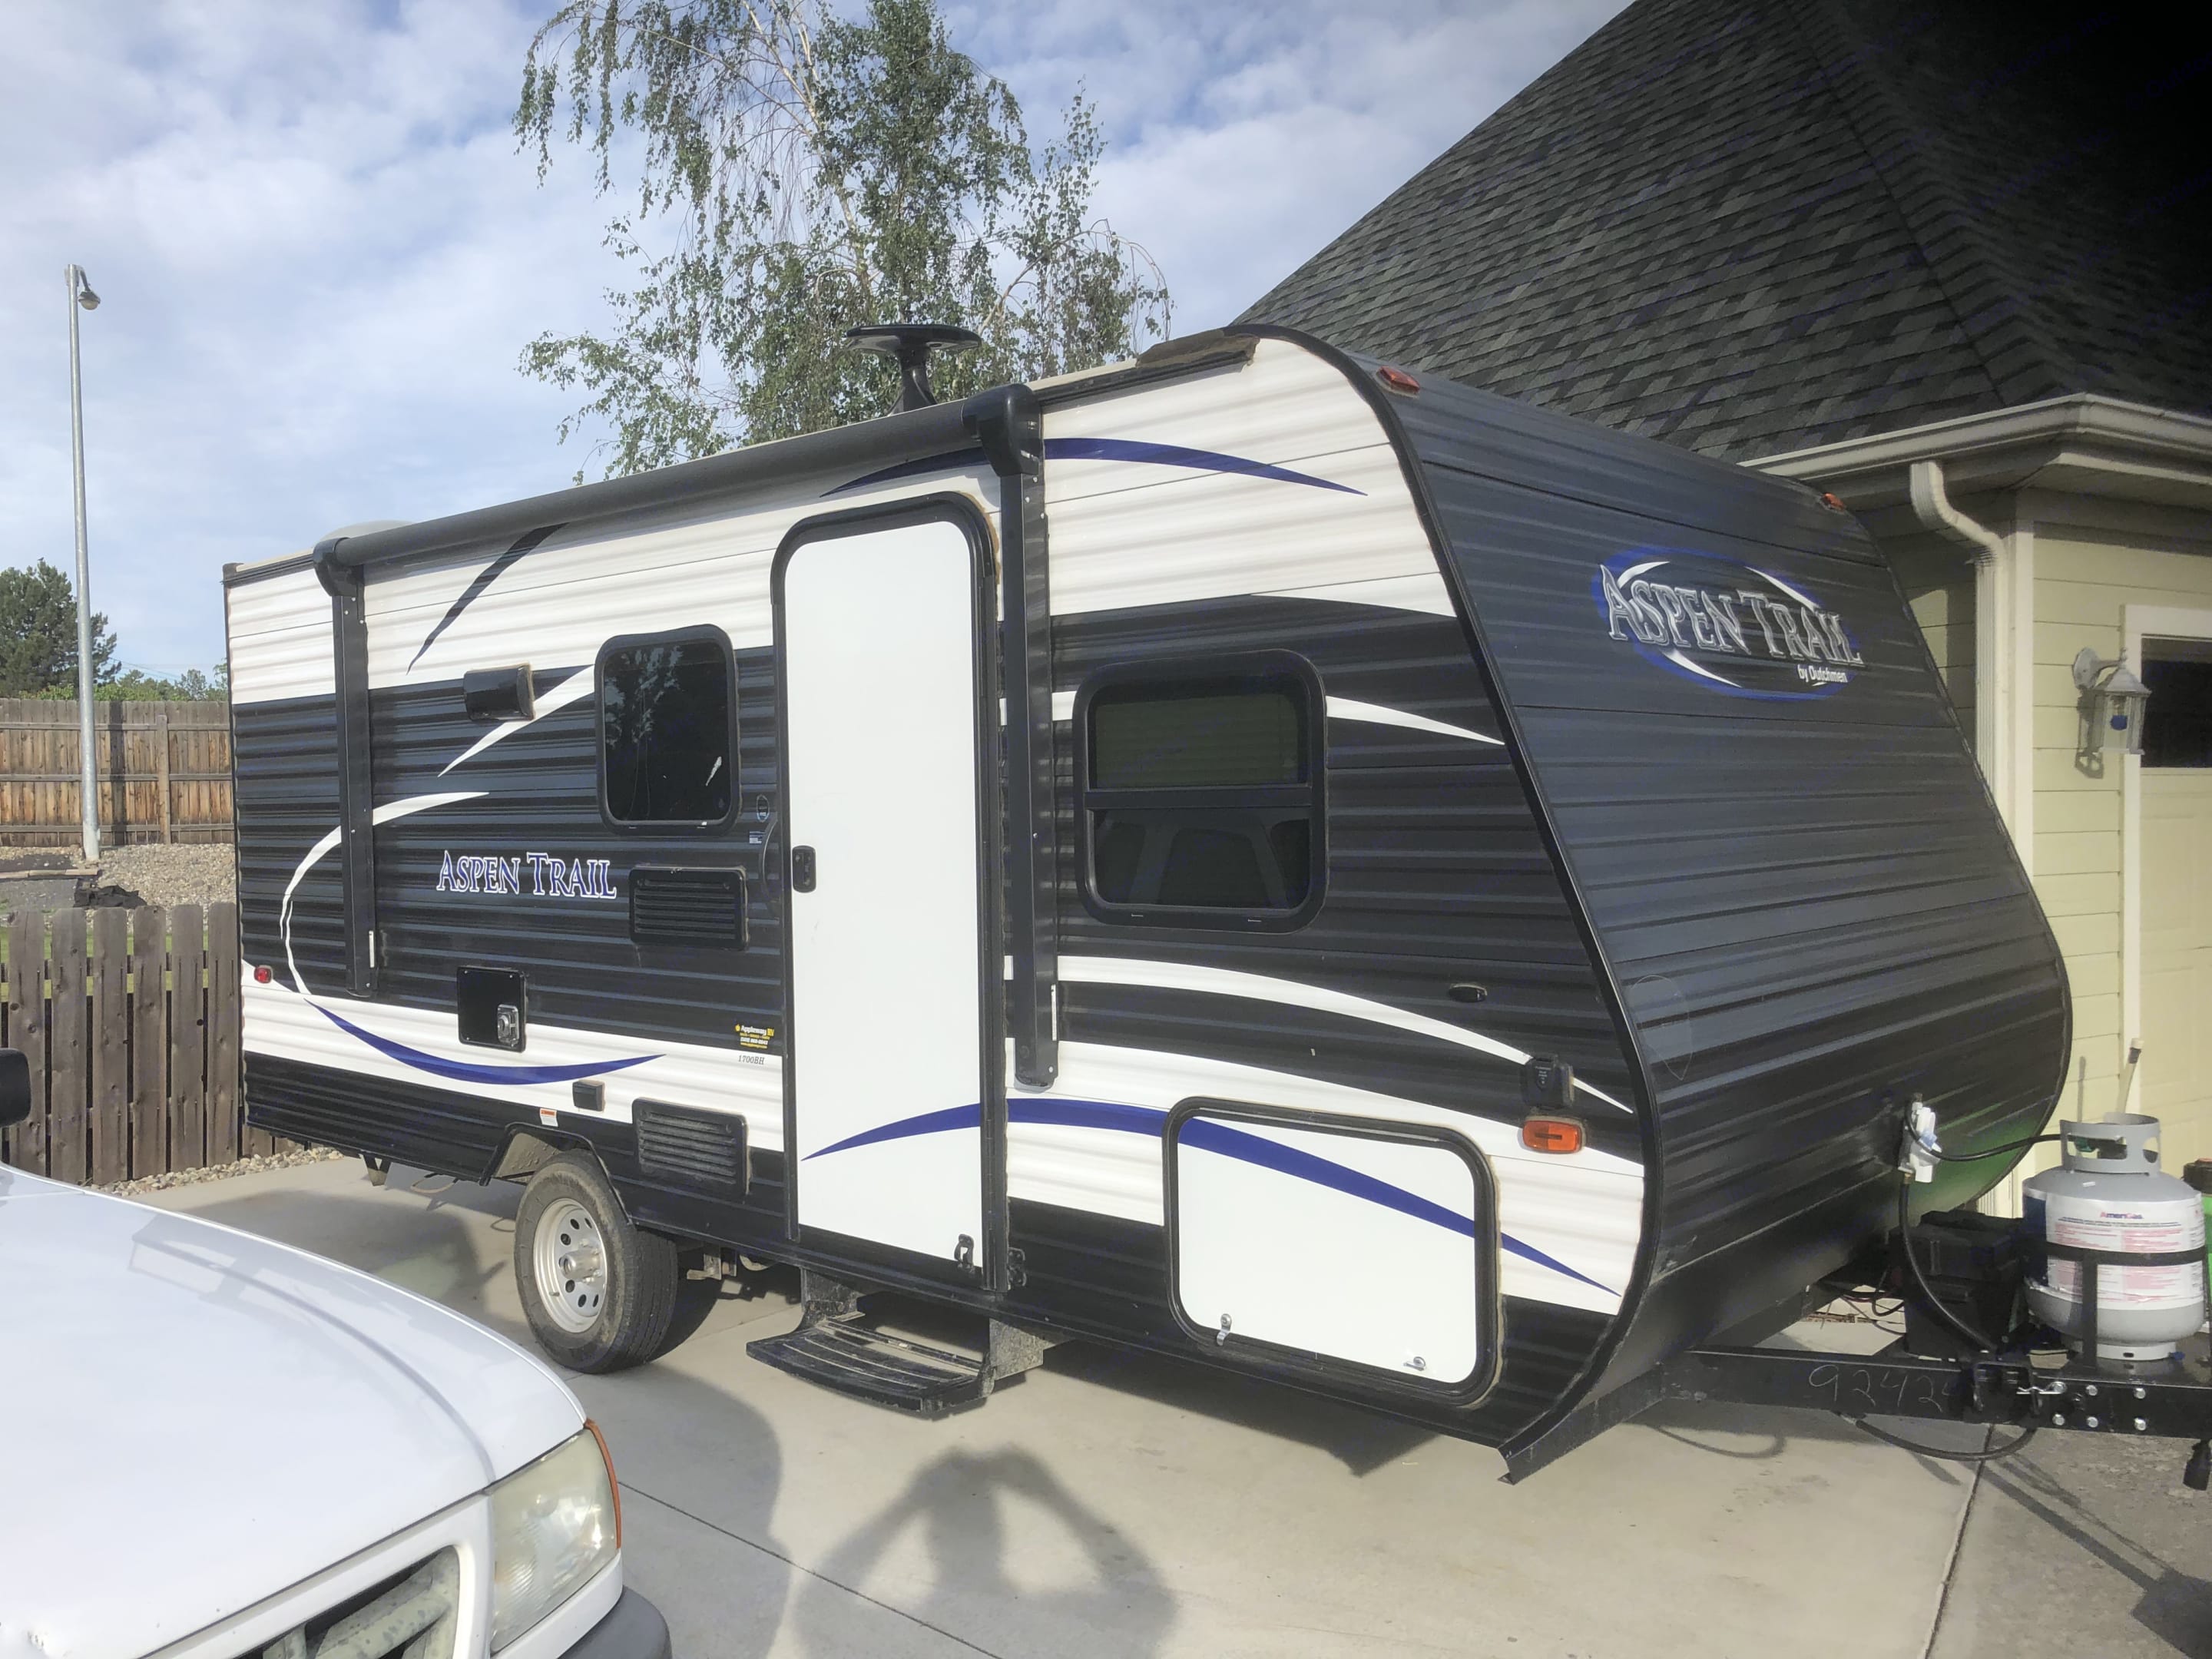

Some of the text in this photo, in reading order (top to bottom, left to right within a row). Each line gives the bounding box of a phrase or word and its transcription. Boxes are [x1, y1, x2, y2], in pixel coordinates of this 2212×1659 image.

[1600, 564, 1865, 667] ASPEN TRAIL
[1797, 664, 1848, 683] by Dutchmen
[436, 850, 616, 899] ASPEN TRAIL
[738, 1055, 765, 1065] 1700BH
